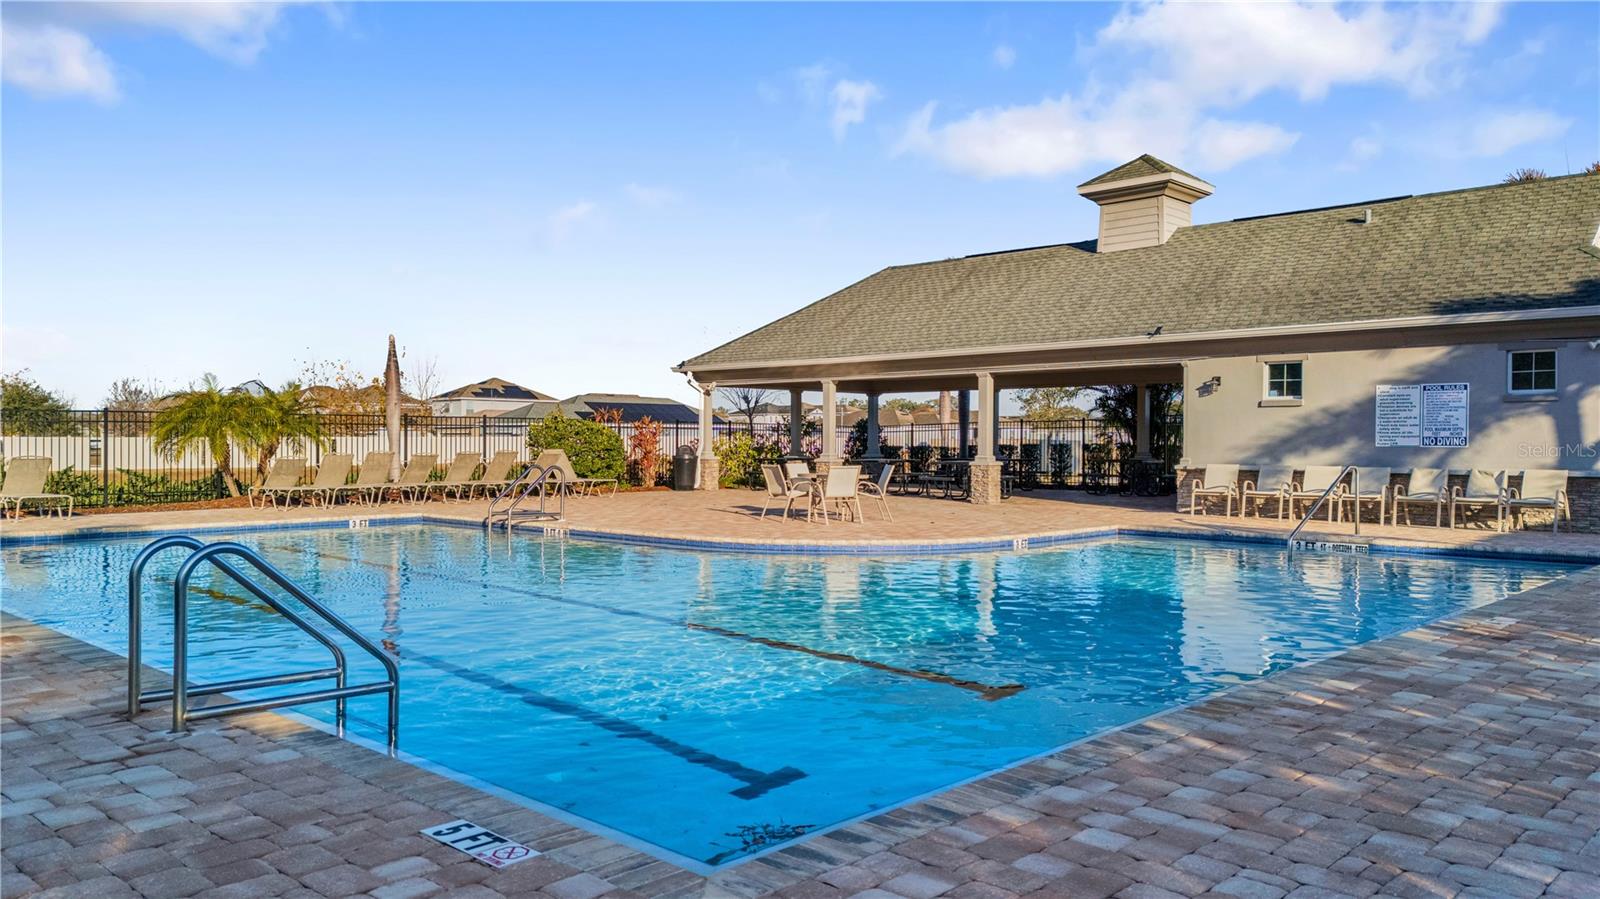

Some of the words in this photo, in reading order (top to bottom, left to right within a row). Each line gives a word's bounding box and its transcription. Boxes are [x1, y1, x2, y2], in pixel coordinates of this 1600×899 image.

[1424, 437, 1435, 446] NO
[1438, 437, 1466, 446] DIVING
[360, 520, 367, 528] FT
[1296, 541, 1301, 550] 3
[432, 823, 476, 836] 5
[451, 831, 509, 850] FT
